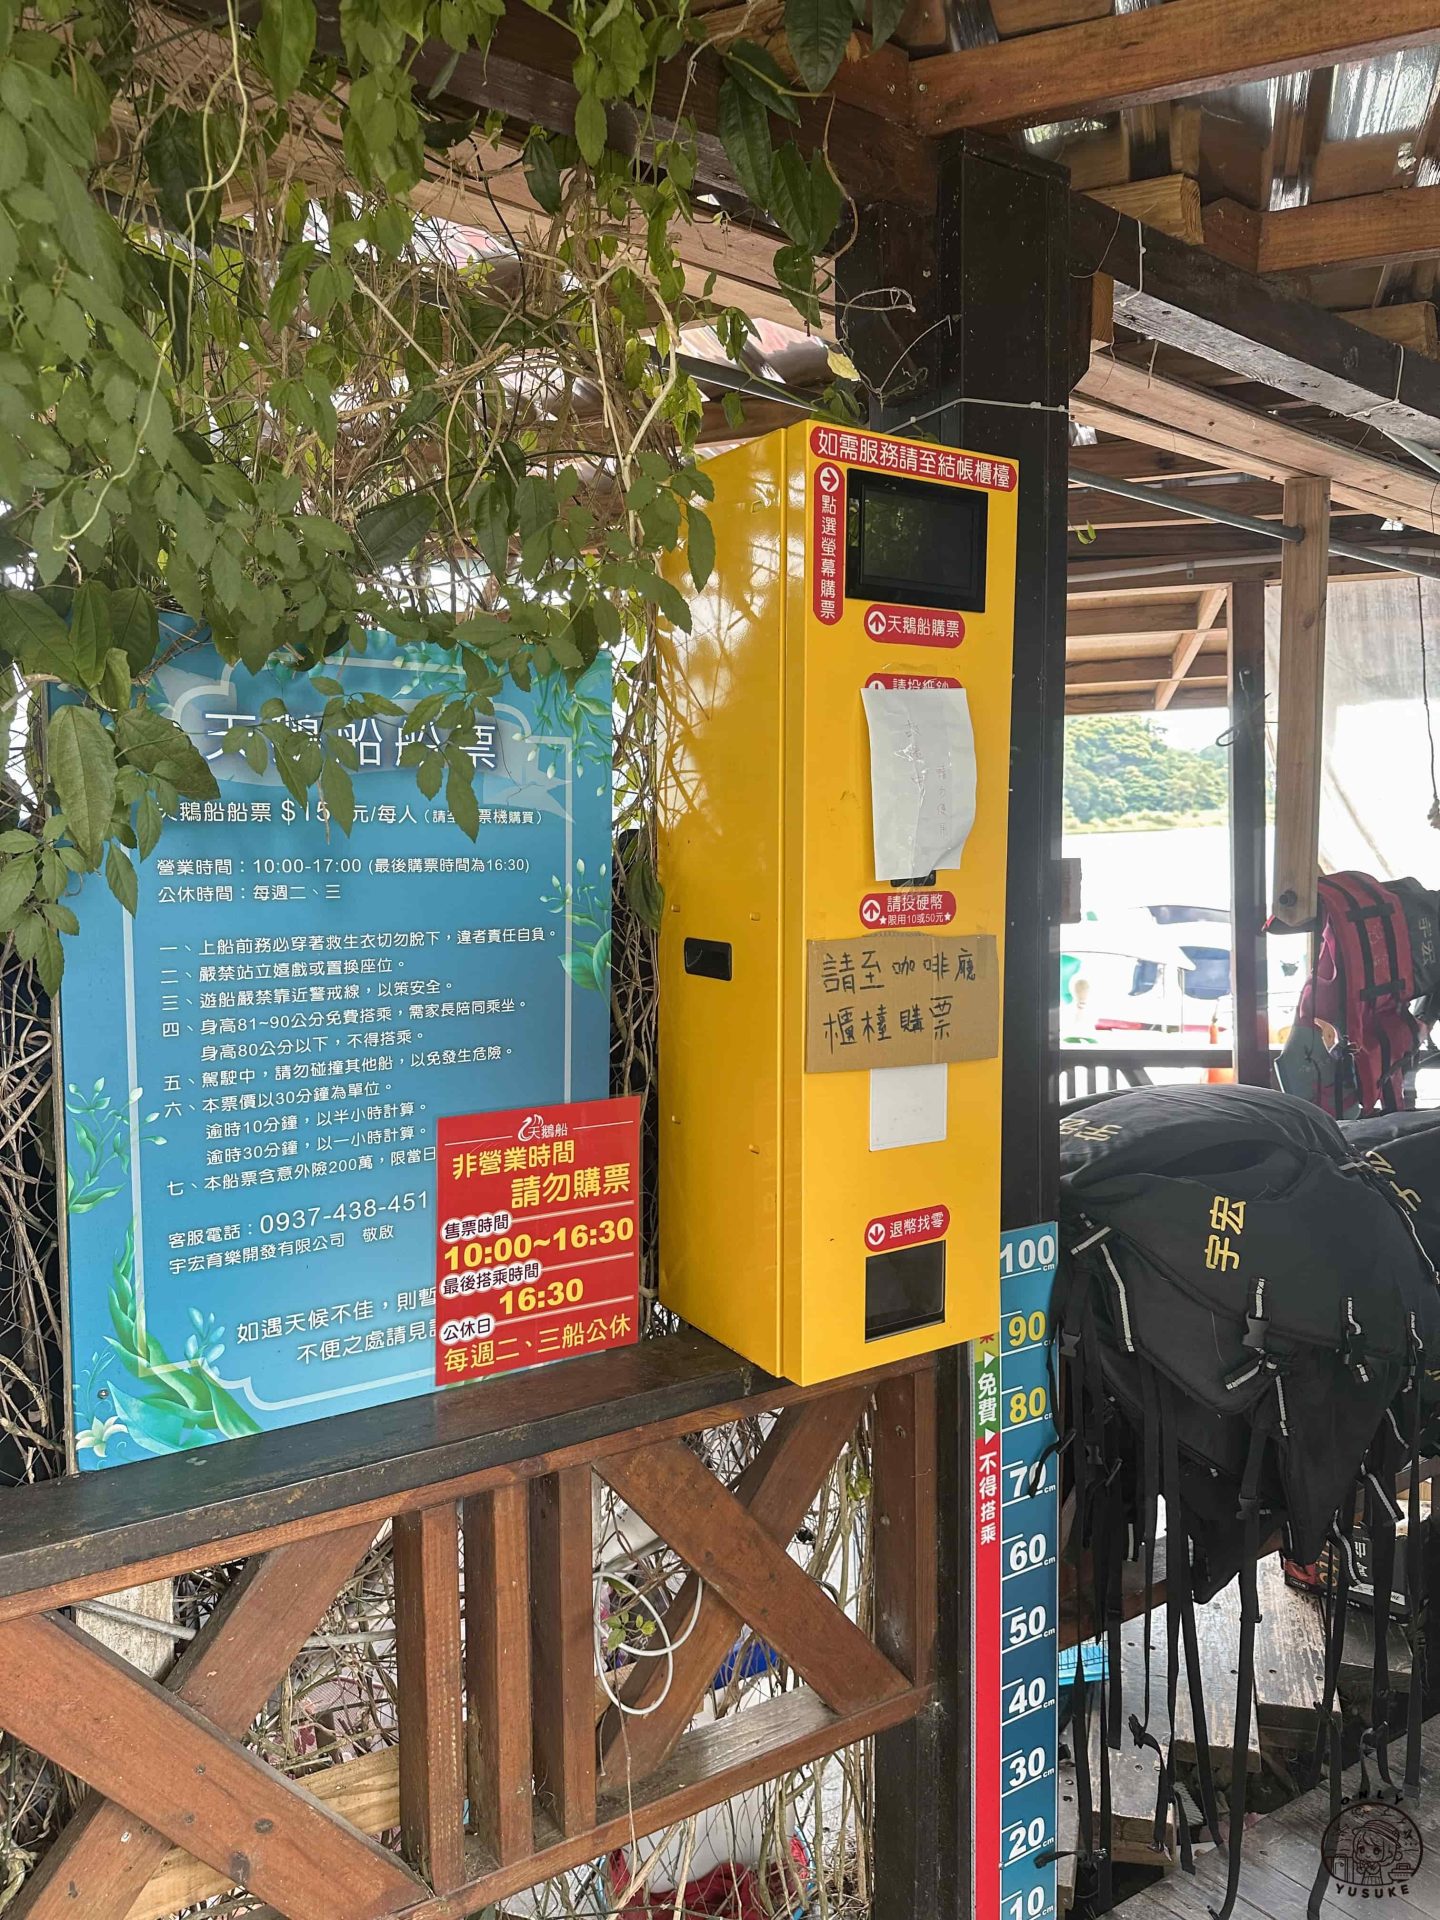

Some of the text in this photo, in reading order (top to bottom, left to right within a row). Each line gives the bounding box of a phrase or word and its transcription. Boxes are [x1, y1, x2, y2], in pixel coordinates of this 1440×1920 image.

[817, 429, 1010, 489] 如需服務請至結帳櫃檯
[820, 495, 837, 619] 點選螢幕購票
[887, 614, 960, 638] 天鵝船購票
[157, 802, 272, 822] 鵝船船票
[158, 884, 341, 903] 公休時間：每週二、三
[887, 893, 943, 912] 請投硬幣
[528, 1123, 568, 1139] 天鵝船
[452, 1140, 575, 1180] 非營業時間
[511, 1162, 631, 1209] 請勿購票
[444, 1214, 509, 1240] 售票時間
[444, 1217, 634, 1271] 10:00~16:30
[889, 1211, 944, 1239] 退幣找零
[1204, 1195, 1247, 1272] 宇宏
[169, 1232, 345, 1275] 宇宏育樂開發有限公司
[1000, 1234, 1055, 1273] 100 cm
[443, 1262, 539, 1295] 最後搭乘時間
[499, 1278, 584, 1315] 16:30
[443, 1317, 491, 1342] 公休日
[443, 1313, 631, 1373] 每週二、三船公休
[1008, 1311, 1046, 1347] 90
[978, 1372, 997, 1425] 免費
[1009, 1387, 1046, 1424] 80
[979, 1451, 997, 1545] 不得搭乘
[1009, 1461, 1047, 1498] 70
[1009, 1533, 1056, 1571] 60 cm
[1009, 1605, 1056, 1645] 50 cm
[1008, 1677, 1055, 1715] 40 cm
[1009, 1747, 1055, 1787] 30 cm
[1008, 1817, 1054, 1860] 20 cm
[1009, 1886, 1054, 1920] 10 cm
